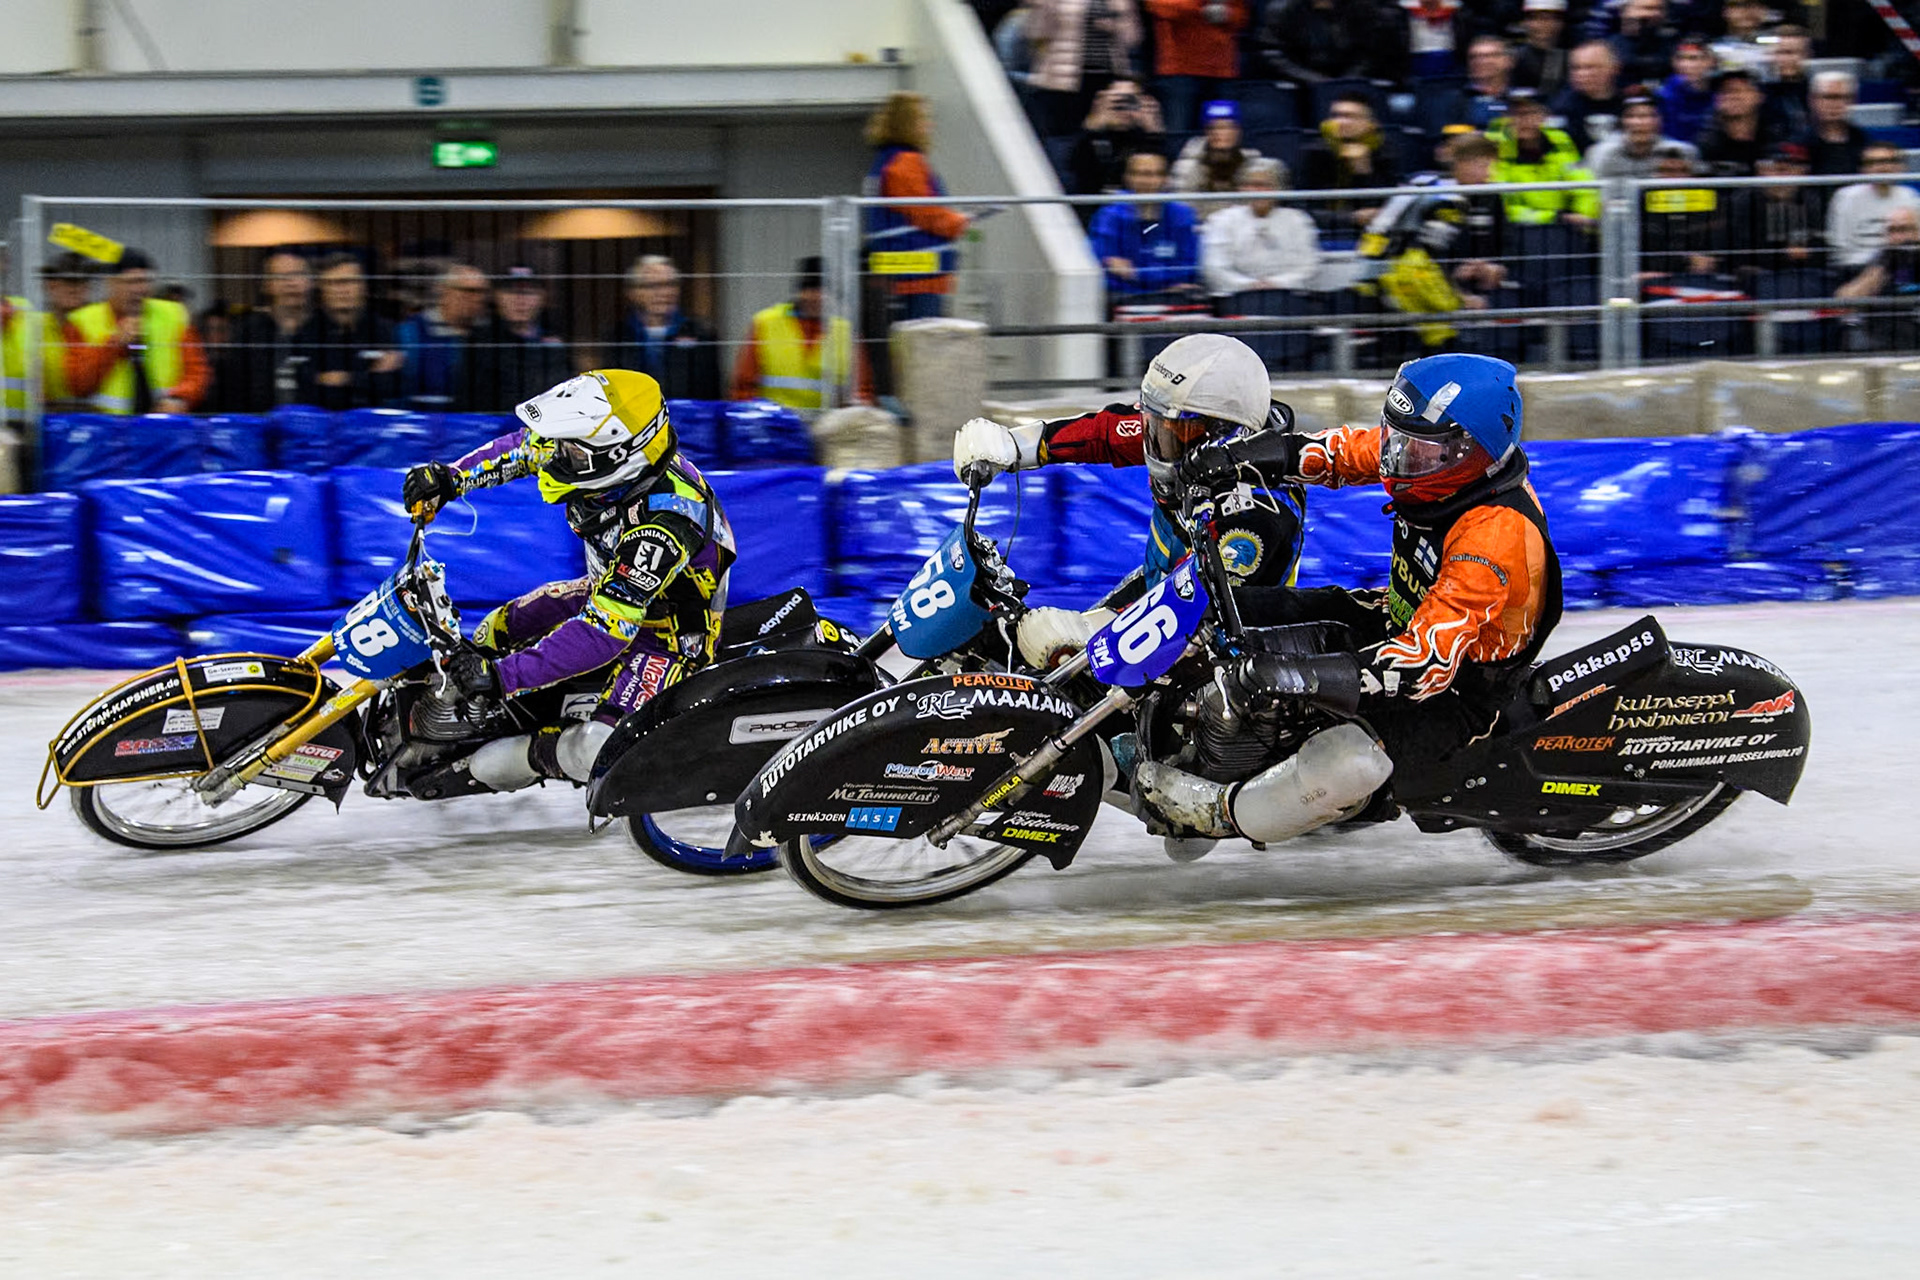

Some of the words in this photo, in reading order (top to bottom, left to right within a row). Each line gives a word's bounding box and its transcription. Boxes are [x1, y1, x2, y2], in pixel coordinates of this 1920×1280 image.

[1389, 391, 1410, 412] HJC
[908, 549, 956, 619] 58
[1111, 581, 1179, 665] 66
[1093, 635, 1115, 668] FIM
[1547, 631, 1655, 693] pekkap58
[952, 674, 1035, 692] PEAKOTEK
[762, 707, 868, 799] AUTOTARVIKE
[872, 695, 900, 718] OY
[1534, 736, 1616, 752] PEAKOTEK
[1618, 735, 1748, 756] AUTOTARVIKE
[1748, 734, 1778, 745] OY
[1650, 755, 1726, 769] POHJANMAAN
[982, 775, 1021, 808] HAKALA
[1541, 781, 1602, 796] DIMEX
[787, 812, 847, 822] SEINÄJOEN
[850, 814, 894, 824] LASI
[1002, 828, 1061, 843] DIMEX
